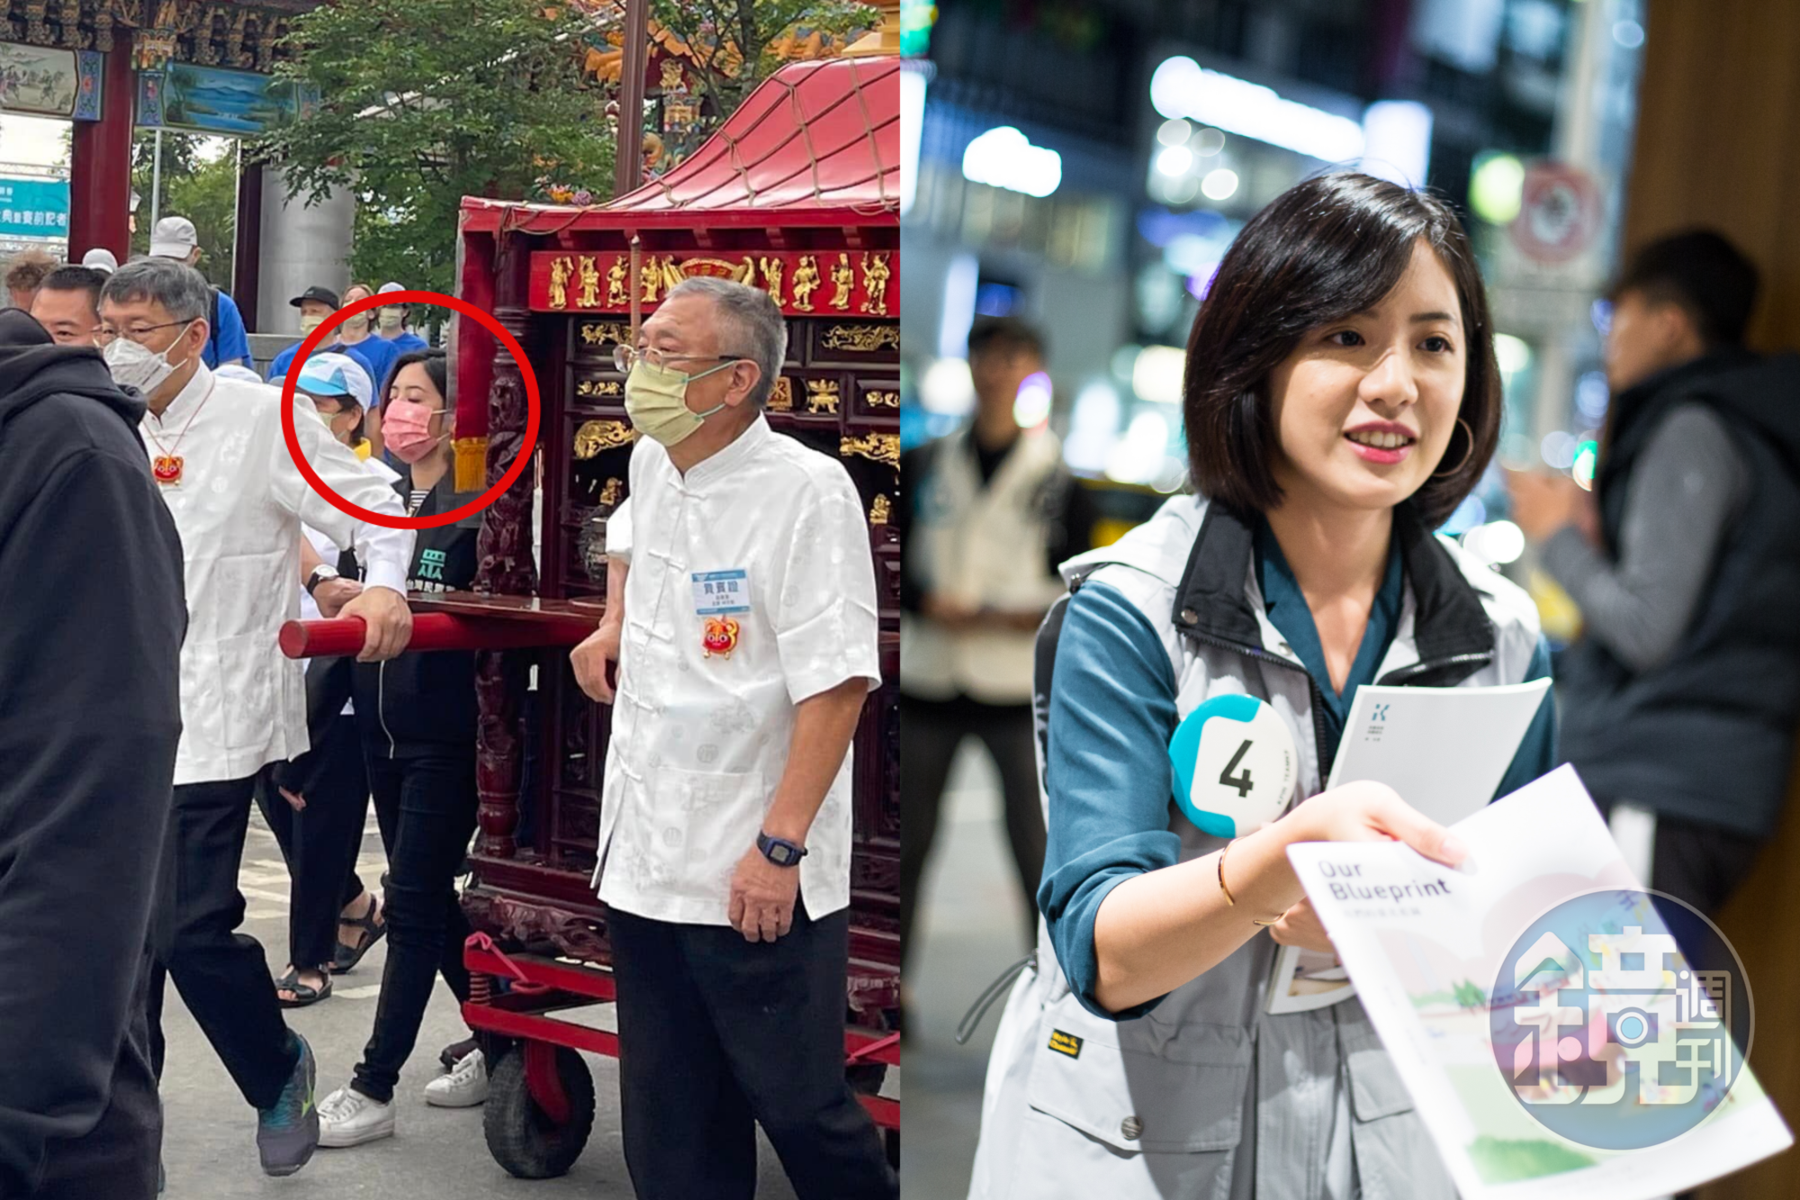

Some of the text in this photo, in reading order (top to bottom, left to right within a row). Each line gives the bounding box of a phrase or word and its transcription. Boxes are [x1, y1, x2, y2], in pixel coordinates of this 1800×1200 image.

[417, 548, 446, 580] 眾
[1218, 738, 1254, 798] 4
[1318, 860, 1362, 878] Our
[1328, 877, 1452, 904] Blueprint
